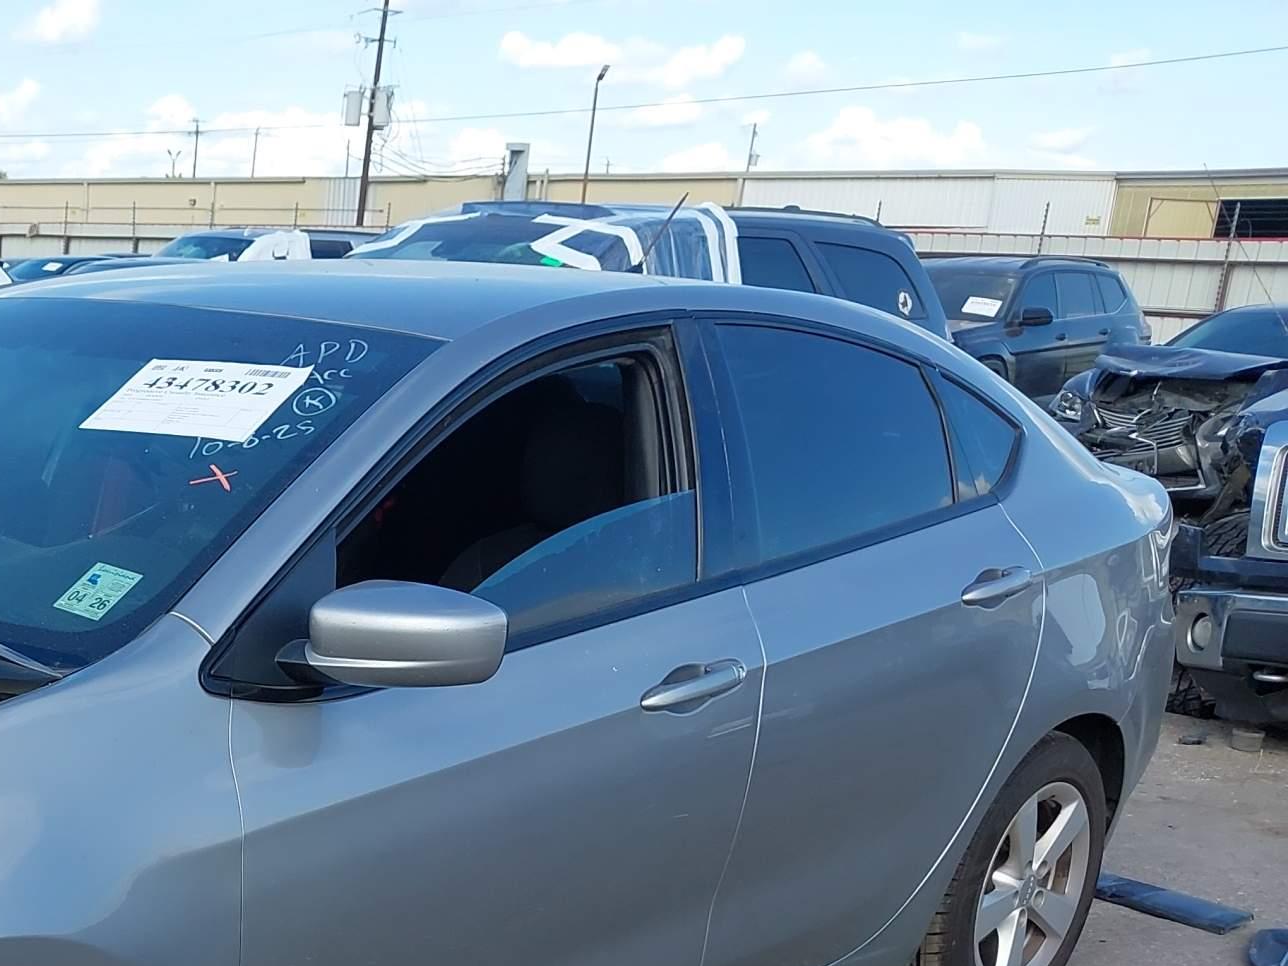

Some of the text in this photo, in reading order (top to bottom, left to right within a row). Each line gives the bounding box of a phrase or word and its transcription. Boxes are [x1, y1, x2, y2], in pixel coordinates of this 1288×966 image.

[279, 338, 369, 368] APD
[142, 375, 275, 397] 43478302
[67, 590, 87, 604] 04
[89, 597, 111, 611] 26
